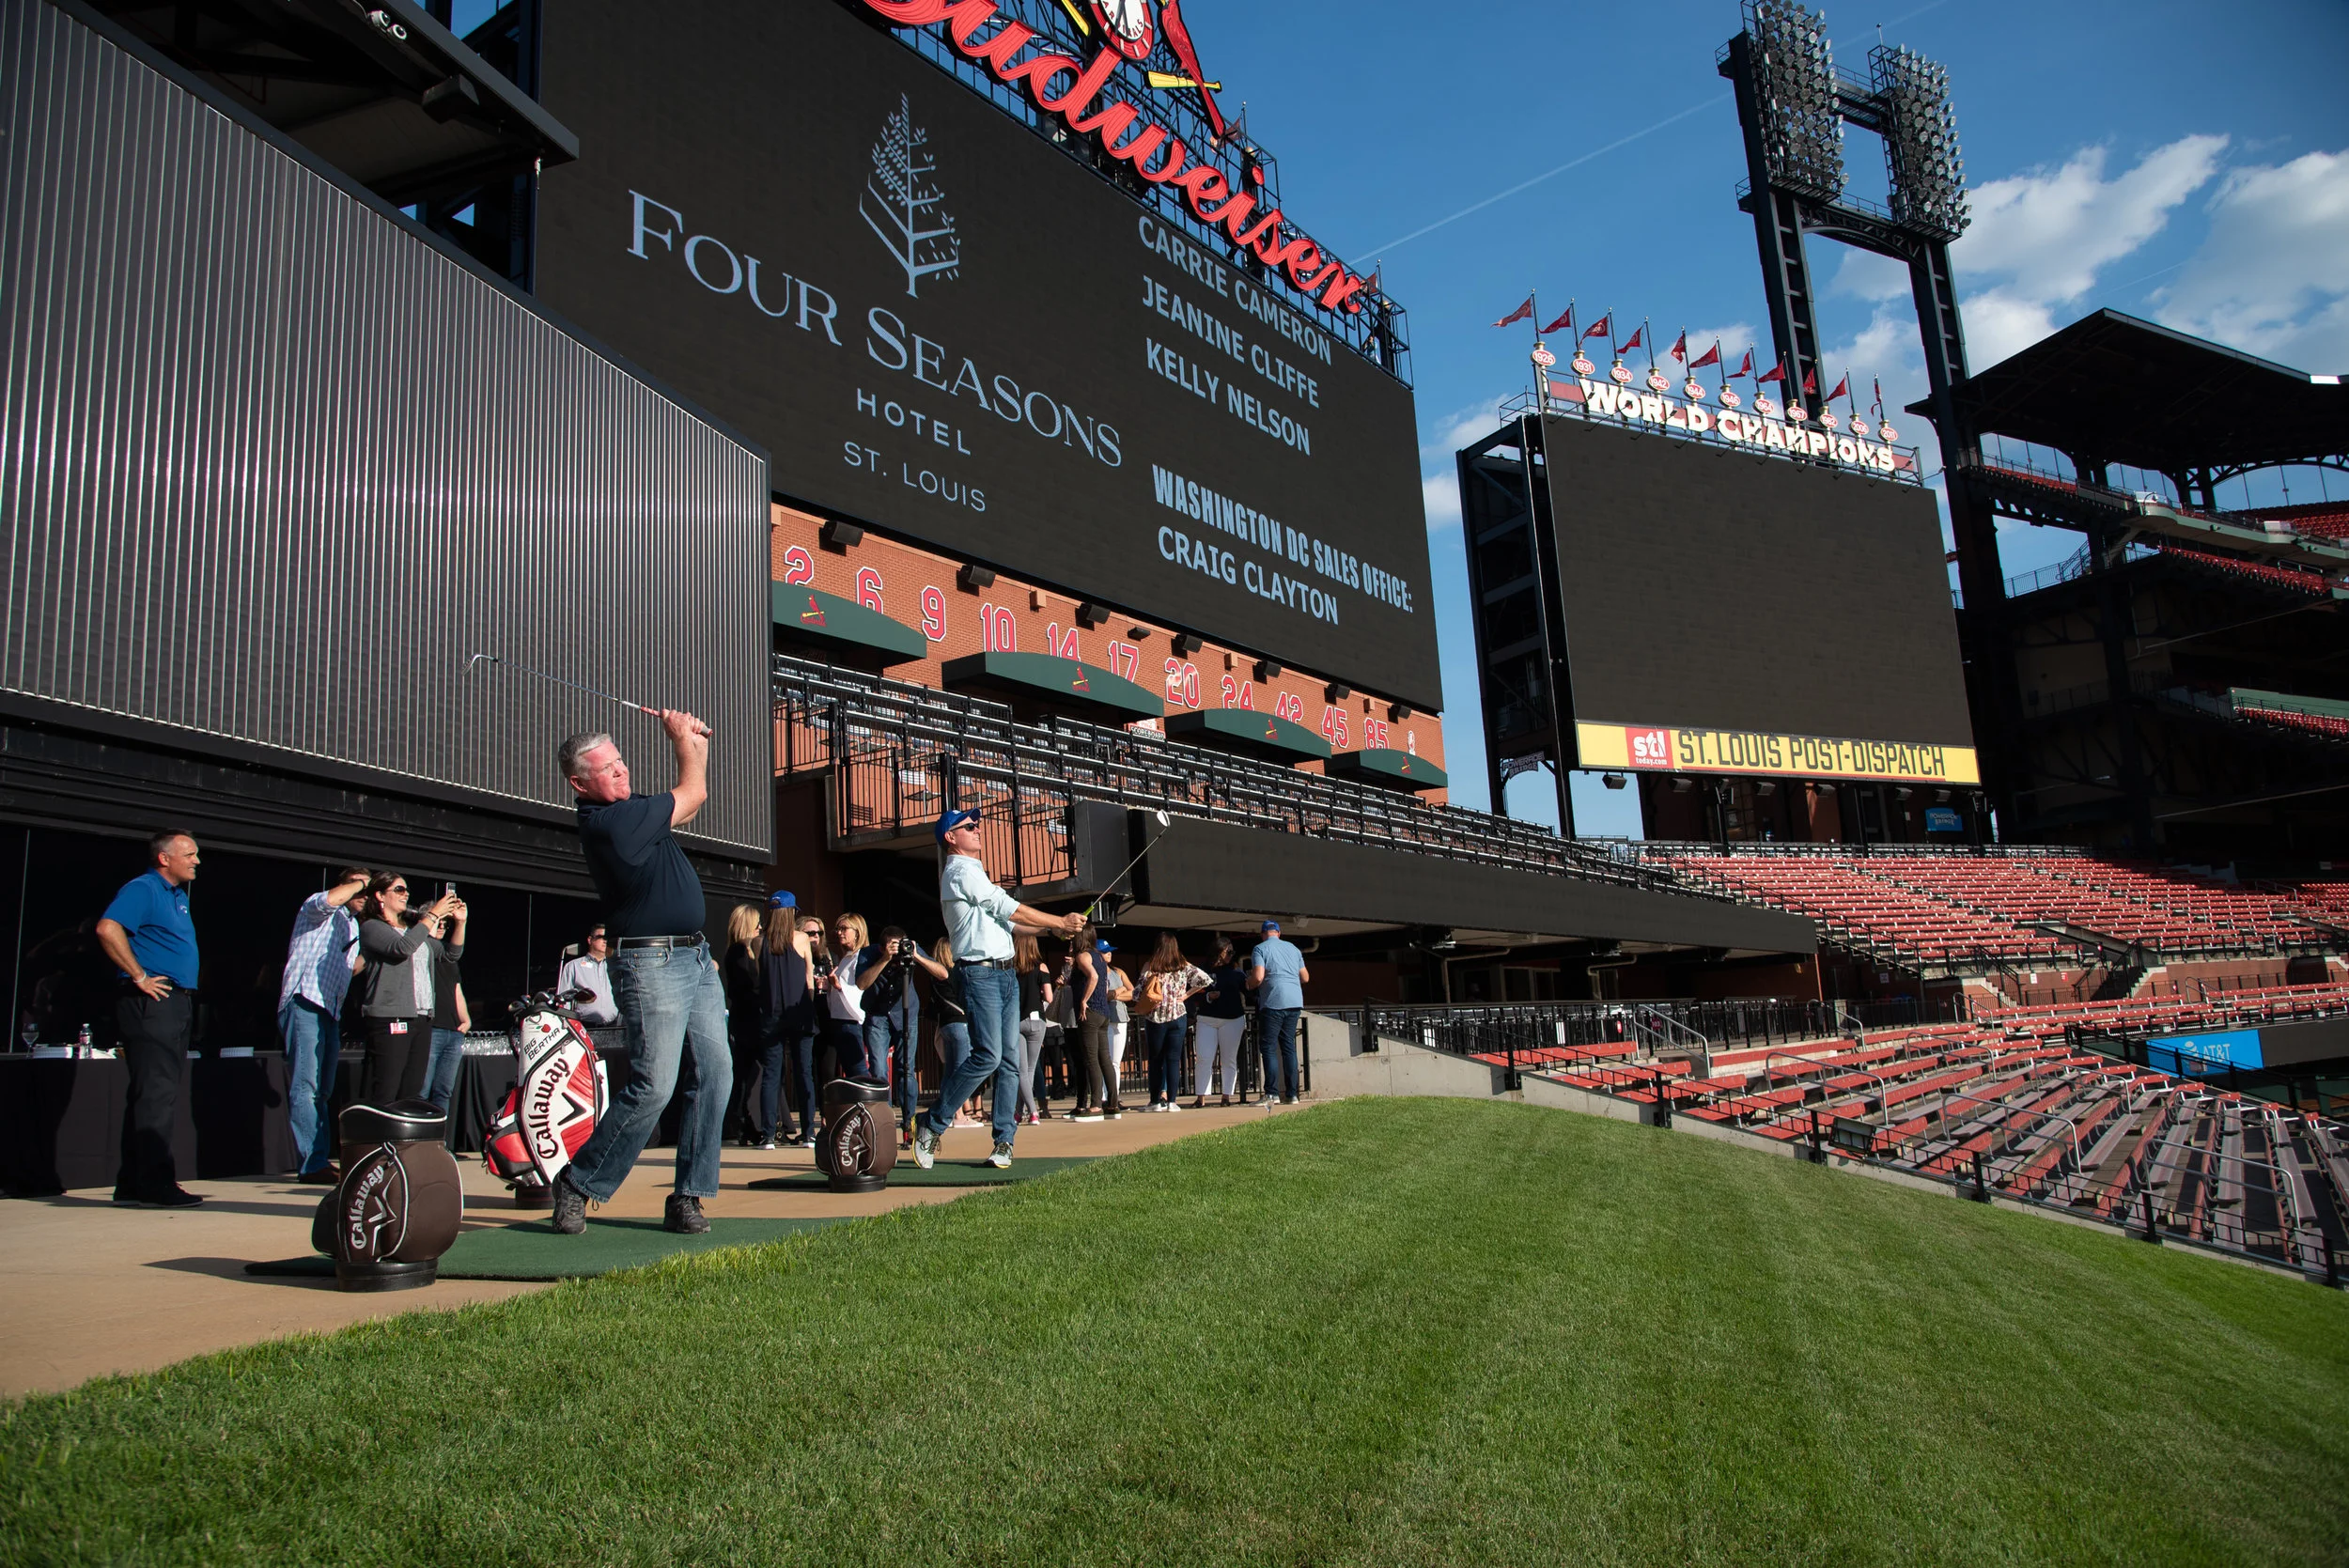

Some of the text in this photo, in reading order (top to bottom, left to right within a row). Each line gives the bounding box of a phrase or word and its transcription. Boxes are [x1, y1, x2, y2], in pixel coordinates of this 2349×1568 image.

[1138, 215, 1332, 366] CARRIE CAMERON
[627, 189, 1123, 468] FOUR SEASONS
[1143, 274, 1319, 409] JEANINE CLIFFE
[1533, 350, 1554, 364] 1926
[1574, 359, 1593, 374] 1931
[1145, 336, 1311, 457] KELLY NELSON
[857, 388, 972, 456] HOTEL
[1579, 378, 1895, 472] WORLD CHAMPIONS
[844, 442, 987, 512] ST. LOUIS
[1152, 464, 1413, 613] WASHINGTON DC SALES OFFICE:
[785, 545, 815, 585] 2
[1158, 525, 1339, 626] CRAIG CLAYTON
[856, 566, 883, 614] 6
[921, 584, 946, 643] 9
[980, 602, 1017, 652] 10
[1047, 622, 1081, 661] 14
[1108, 640, 1140, 683] 17
[1164, 657, 1201, 709] 20
[1221, 674, 1254, 711] 24
[1275, 691, 1304, 724] 42
[1321, 706, 1349, 749] 45
[1364, 717, 1390, 750] 85
[1633, 730, 1667, 758] stl
[1635, 755, 1668, 766] today.com
[1678, 730, 1946, 777] ST. LOUIS POST-DISPATCH
[523, 1037, 537, 1055] BIG
[527, 1027, 562, 1061] BERTHA
[2202, 1043, 2231, 1063] AT&T
[528, 1058, 570, 1159] Callaway
[839, 1115, 862, 1167] Callaway
[349, 1165, 385, 1250] Callaway
